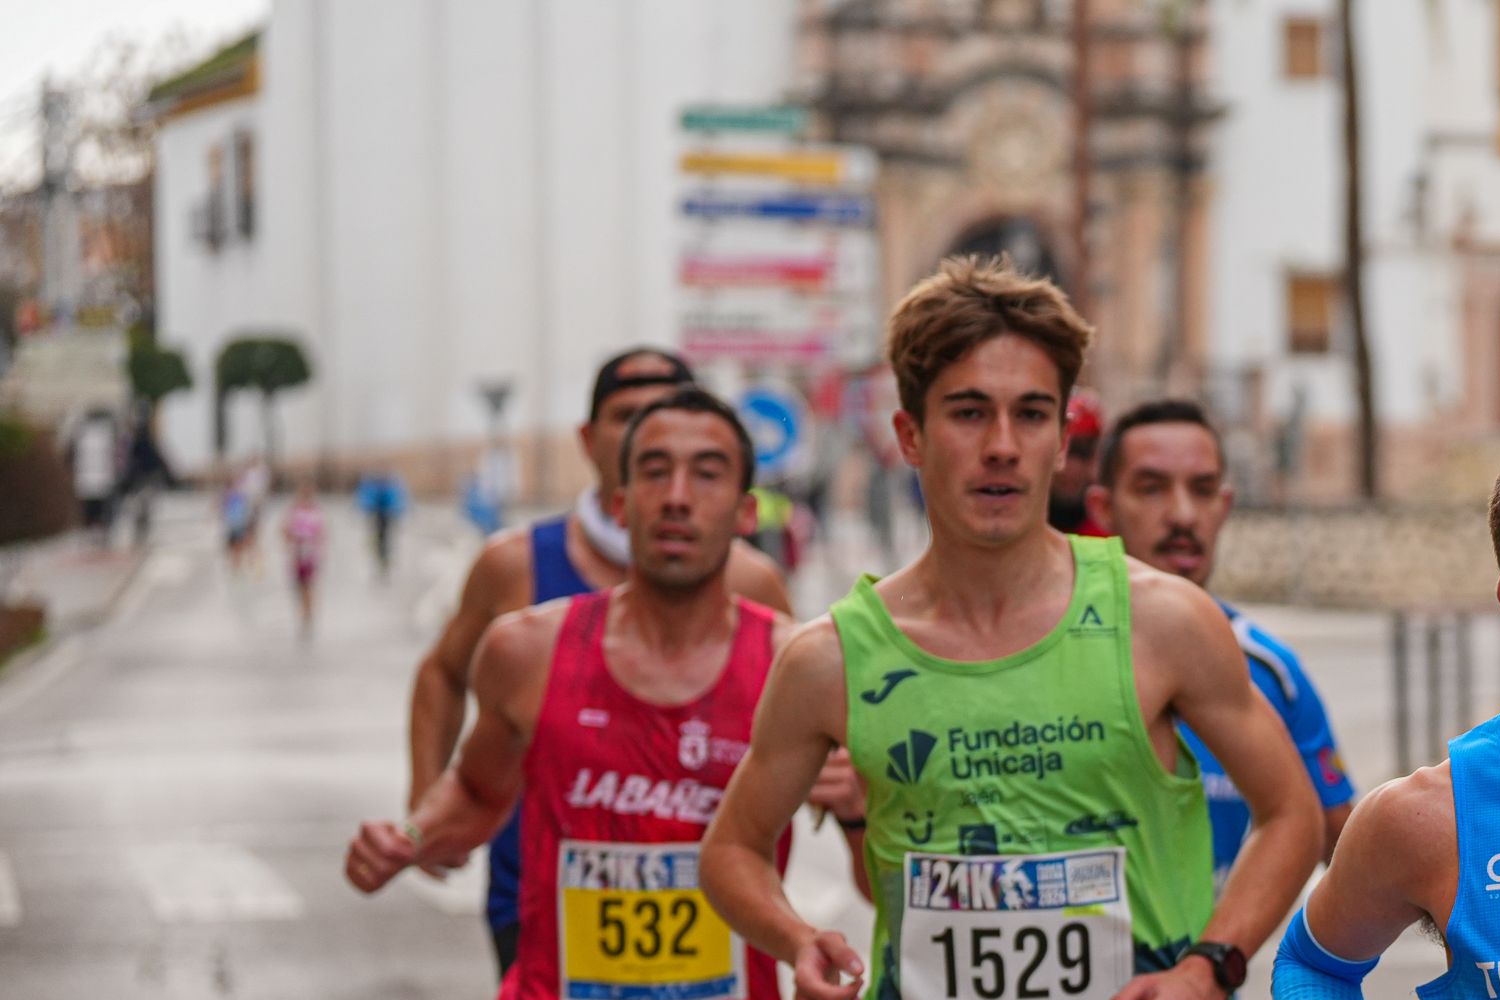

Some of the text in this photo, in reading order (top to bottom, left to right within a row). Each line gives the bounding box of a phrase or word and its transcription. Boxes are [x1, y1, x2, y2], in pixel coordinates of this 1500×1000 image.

[948, 716, 1105, 752] Fundación
[951, 747, 1063, 780] Unicaja
[566, 768, 724, 823] LABAÑE
[930, 860, 997, 909] 21K
[600, 898, 698, 958] 532
[931, 921, 1091, 1000] 1529
